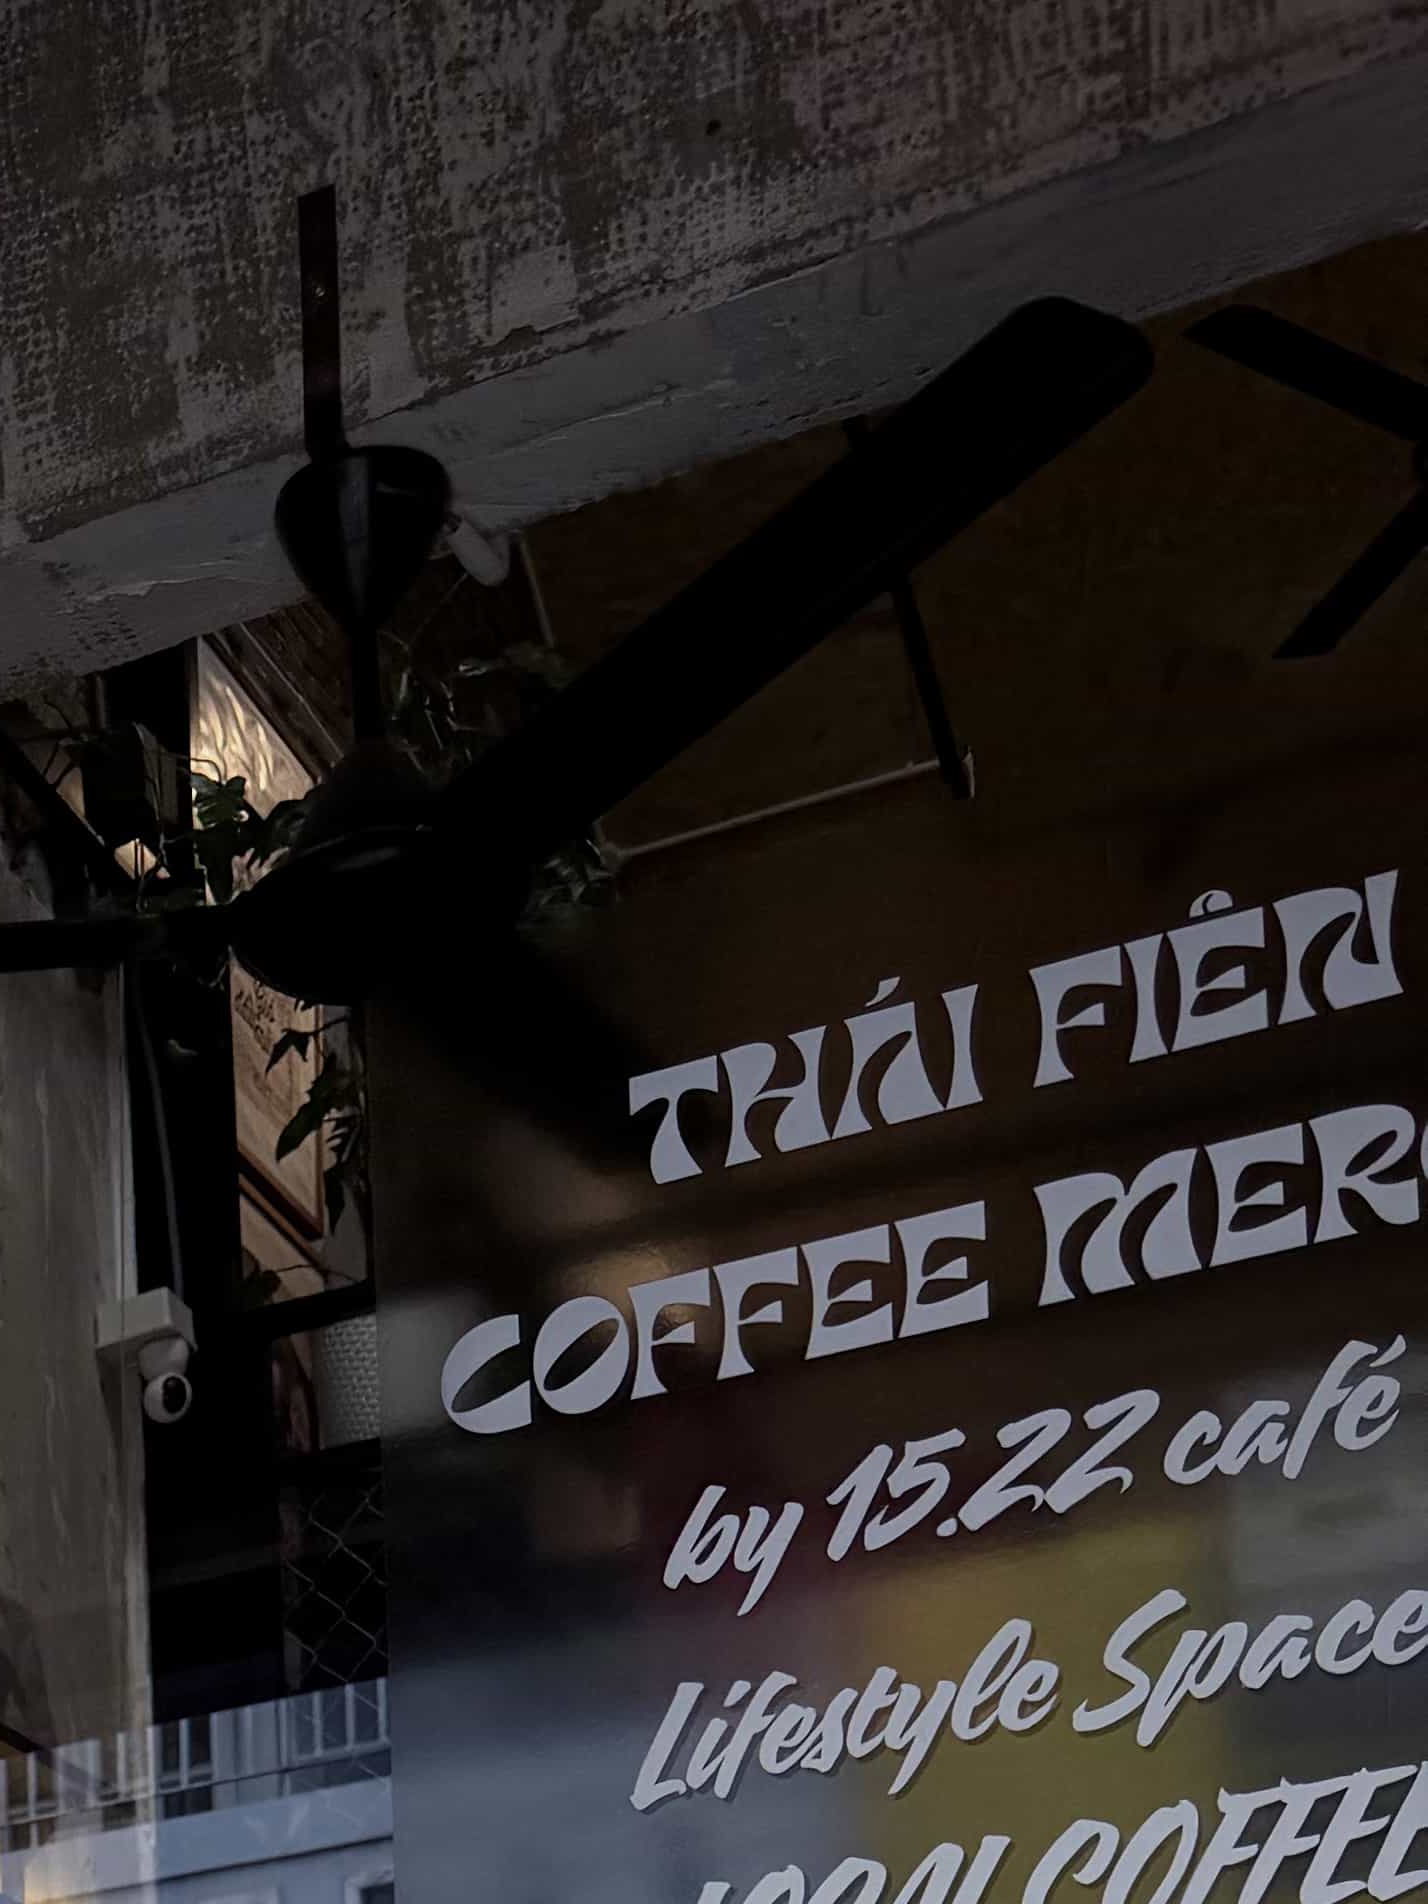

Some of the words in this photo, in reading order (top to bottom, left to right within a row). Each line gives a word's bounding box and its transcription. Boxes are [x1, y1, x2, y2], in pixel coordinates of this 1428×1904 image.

[628, 976, 984, 1184] THÁI
[441, 1200, 988, 1433] COFFEE
[1036, 1103, 1428, 1305] MER
[663, 1486, 803, 1615] by
[824, 1389, 1158, 1561] 15.22
[1163, 1334, 1406, 1485] café
[630, 1618, 1060, 1816] Lifestyle
[1072, 1589, 1428, 1746] Space
